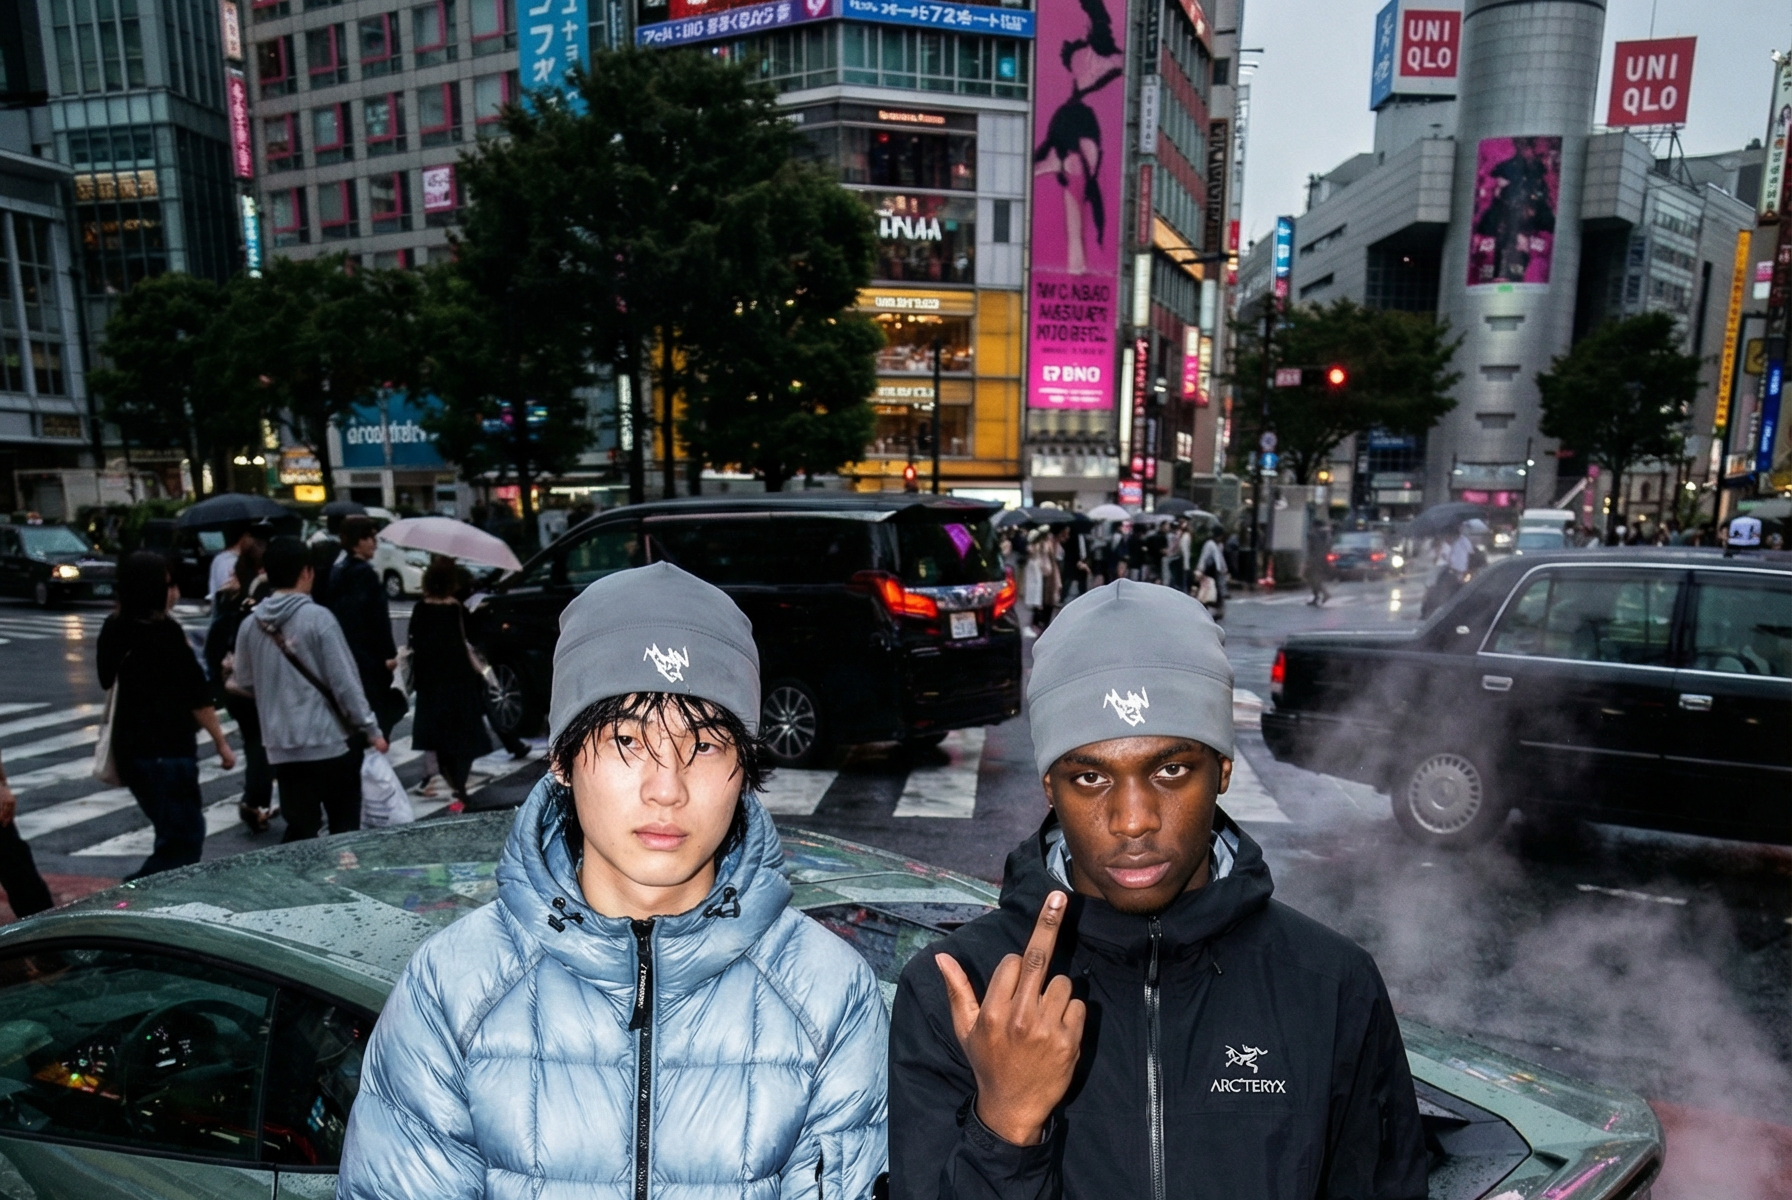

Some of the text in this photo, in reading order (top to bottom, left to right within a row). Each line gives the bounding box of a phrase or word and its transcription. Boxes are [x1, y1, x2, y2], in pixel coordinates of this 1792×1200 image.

[1408, 19, 1450, 42] UNI
[1406, 46, 1452, 71] QLO
[1626, 53, 1679, 82] UNI
[1622, 85, 1678, 115] QLO
